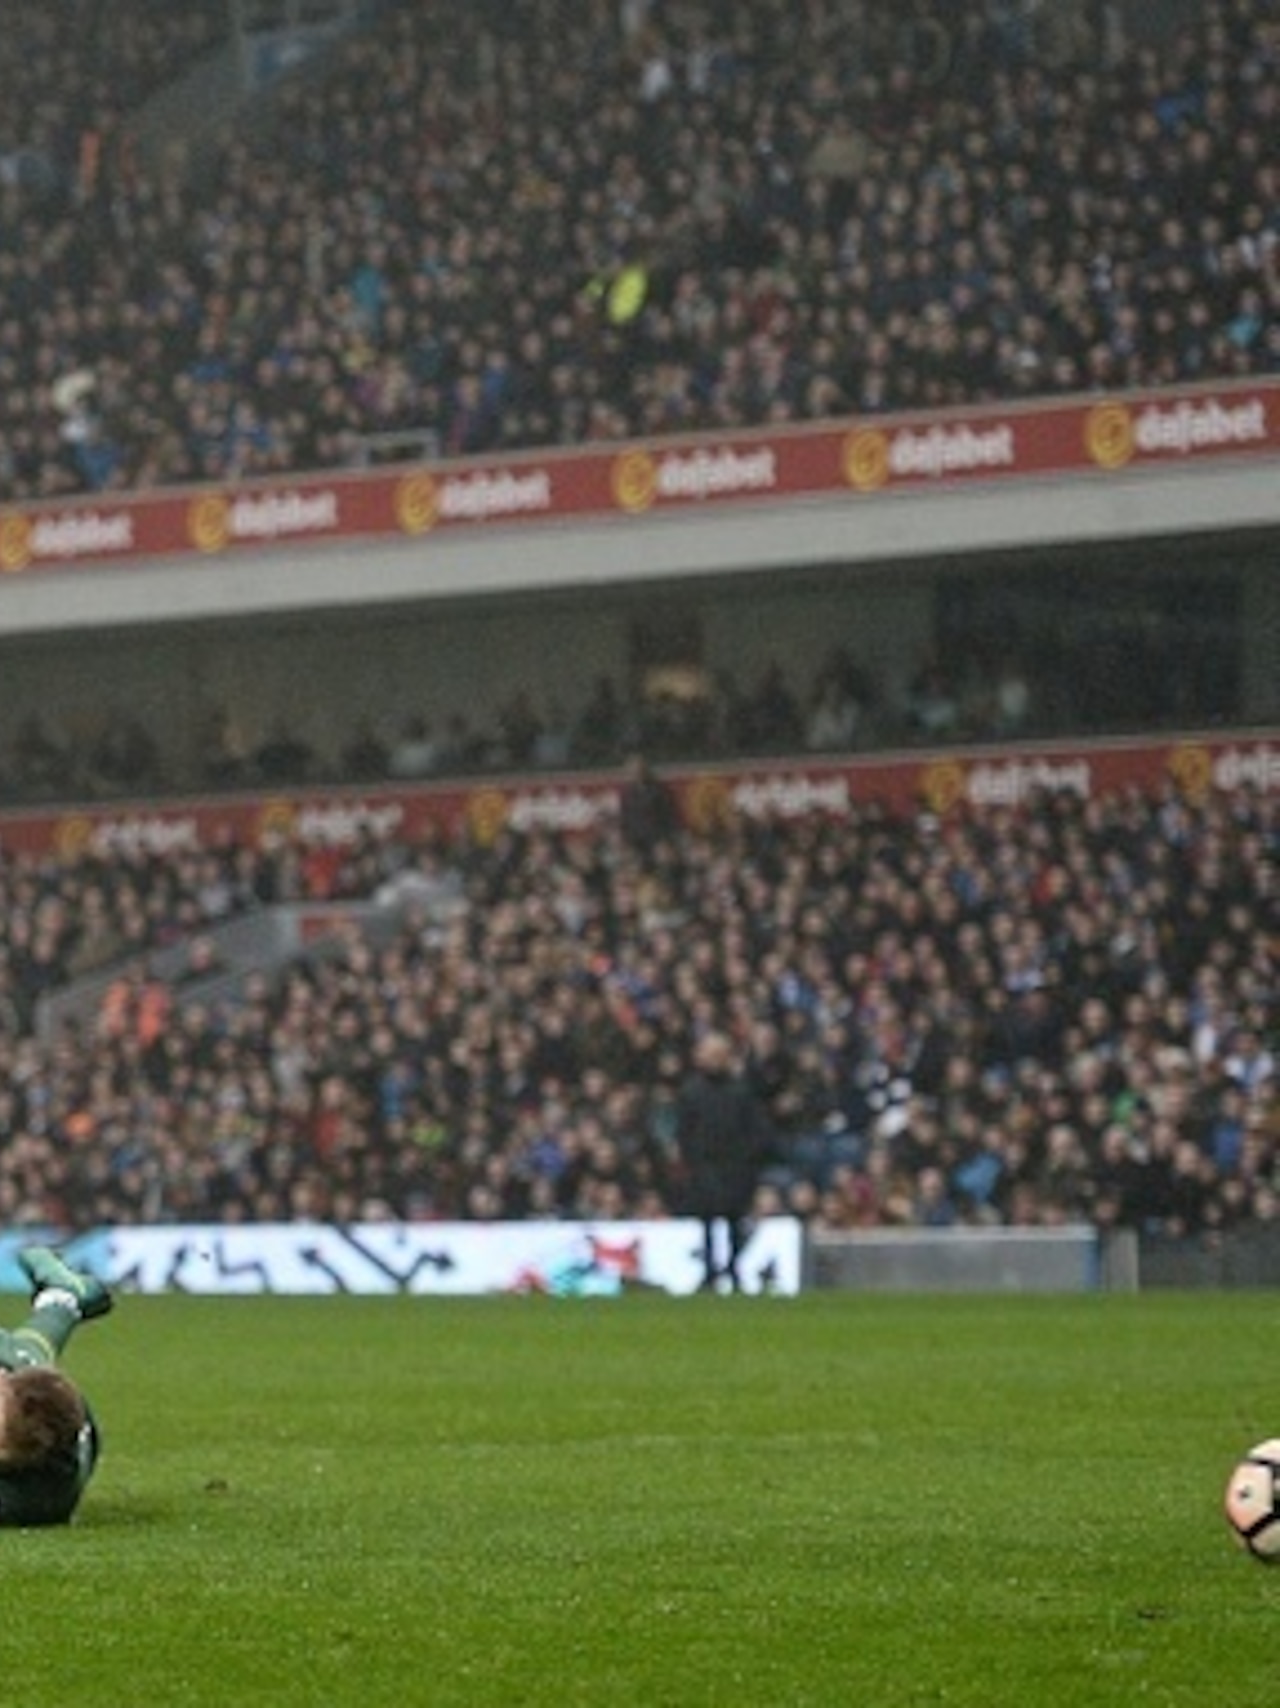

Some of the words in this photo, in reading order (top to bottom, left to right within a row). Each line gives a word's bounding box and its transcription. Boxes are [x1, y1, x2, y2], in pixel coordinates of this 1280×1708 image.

[888, 423, 1015, 477] dafabet
[1134, 399, 1267, 455] dafabet
[656, 446, 778, 500] dafabet
